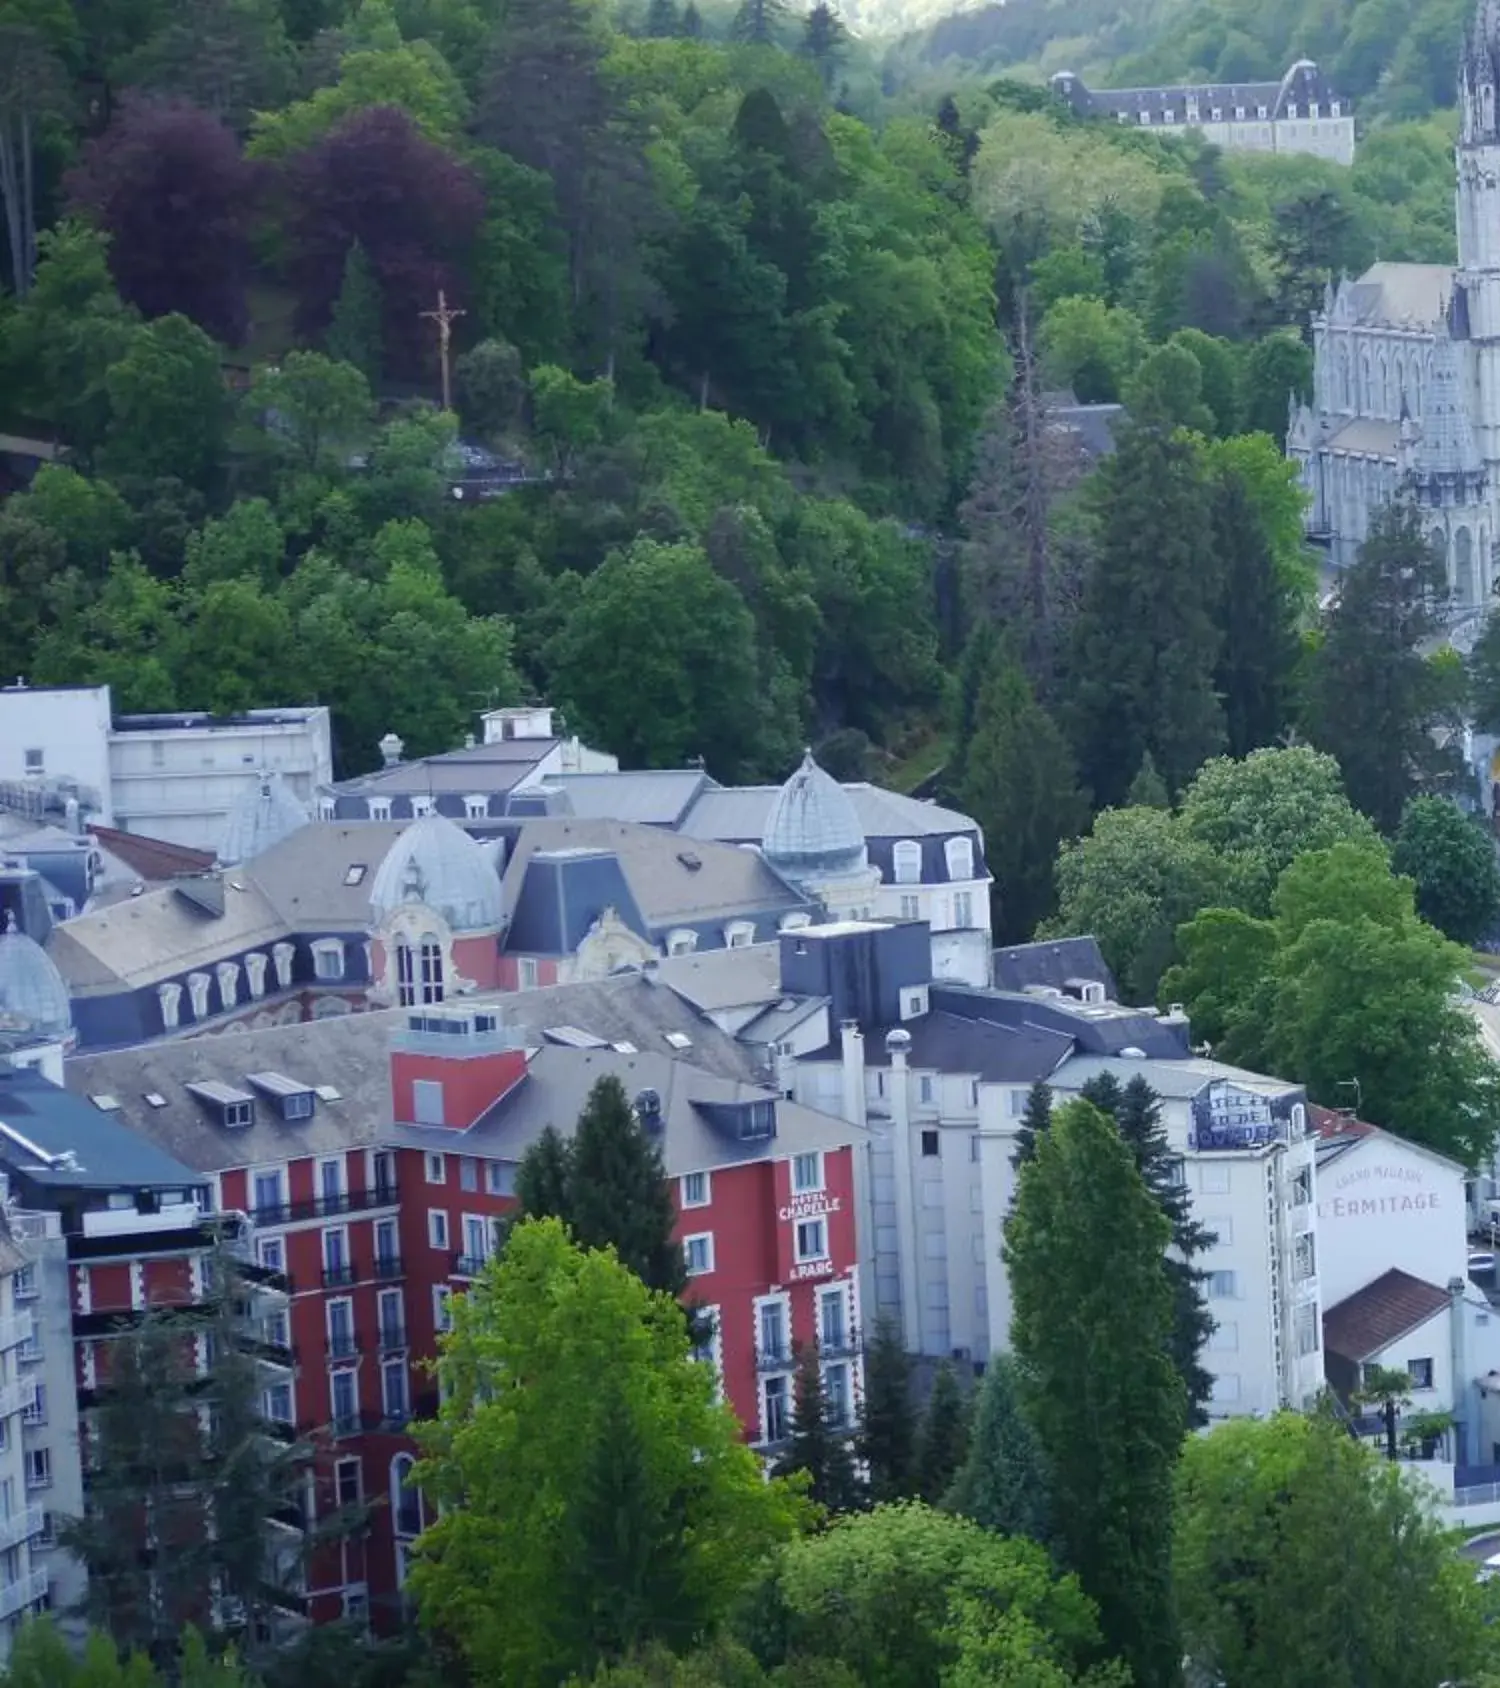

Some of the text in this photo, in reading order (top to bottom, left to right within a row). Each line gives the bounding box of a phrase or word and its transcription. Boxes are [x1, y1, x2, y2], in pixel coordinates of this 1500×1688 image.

[780, 1198, 841, 1221] CHAPELLE
[1316, 1193, 1441, 1218] L'ERMITAGE
[798, 1261, 834, 1279] PARC
